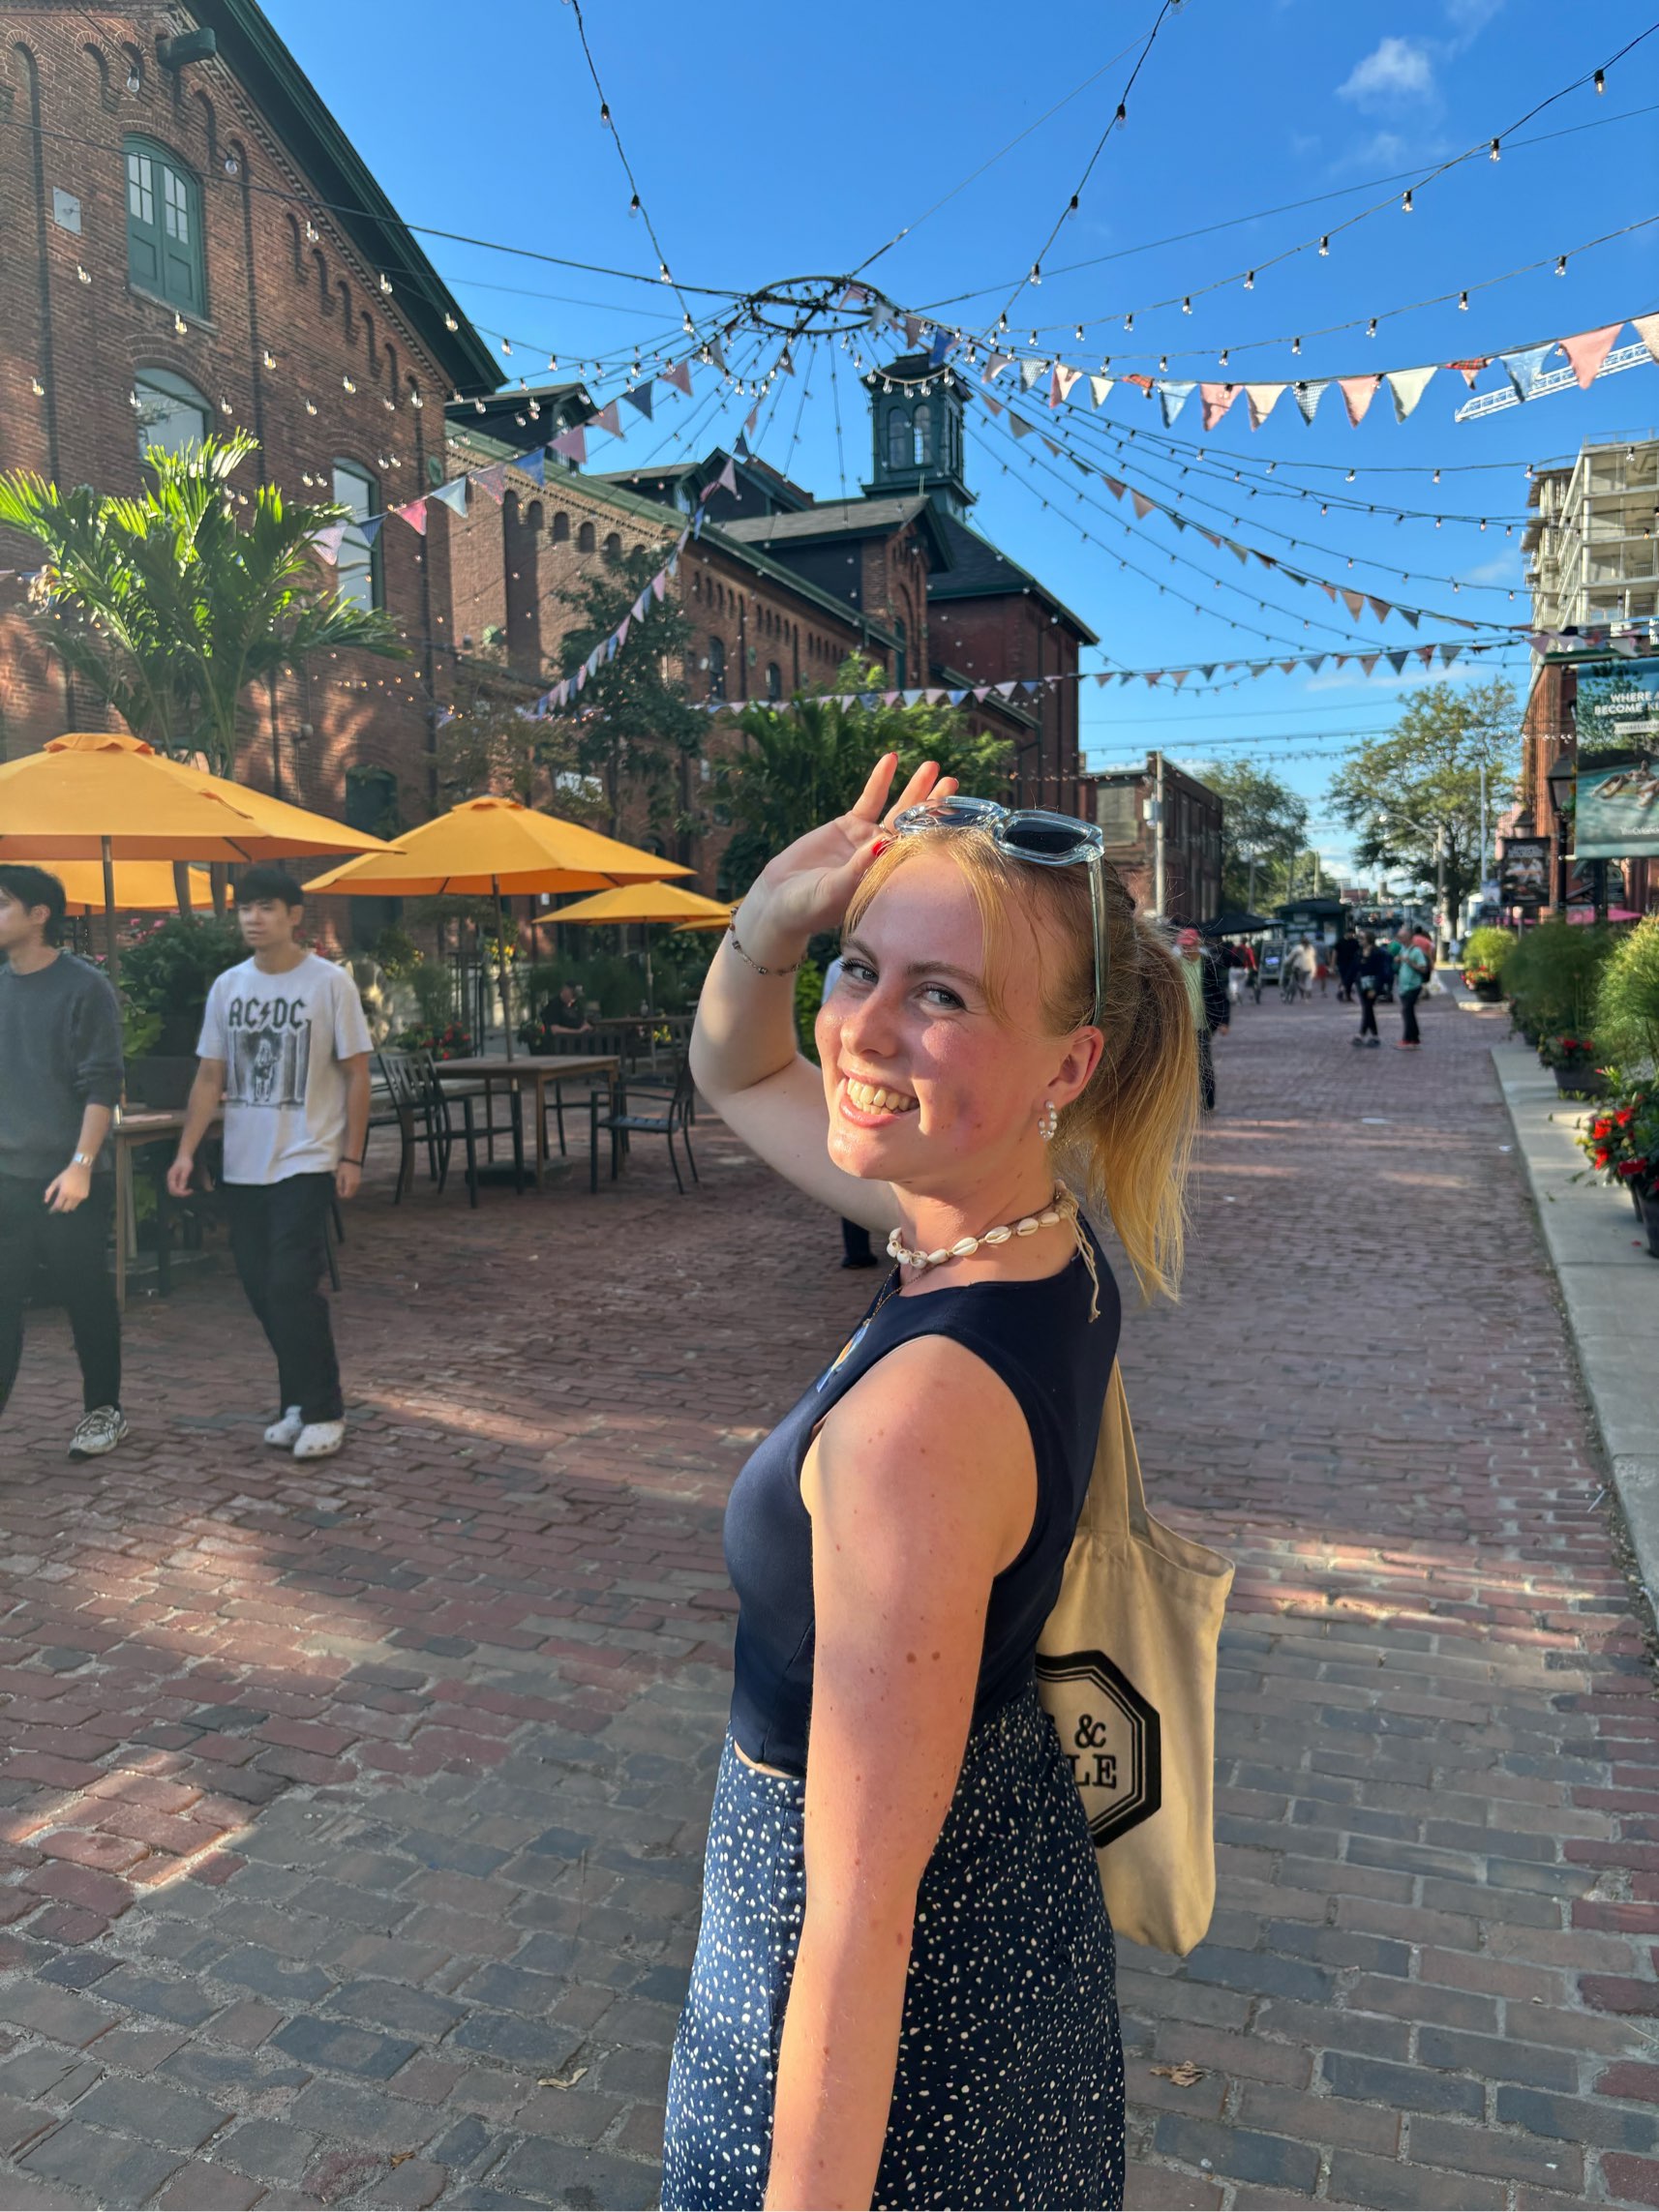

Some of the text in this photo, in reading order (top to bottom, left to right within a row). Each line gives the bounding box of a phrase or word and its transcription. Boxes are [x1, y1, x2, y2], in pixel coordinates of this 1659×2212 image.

[1610, 690, 1652, 703] WHERE
[1593, 702, 1644, 716] BECOME
[1074, 1714, 1106, 1749] &
